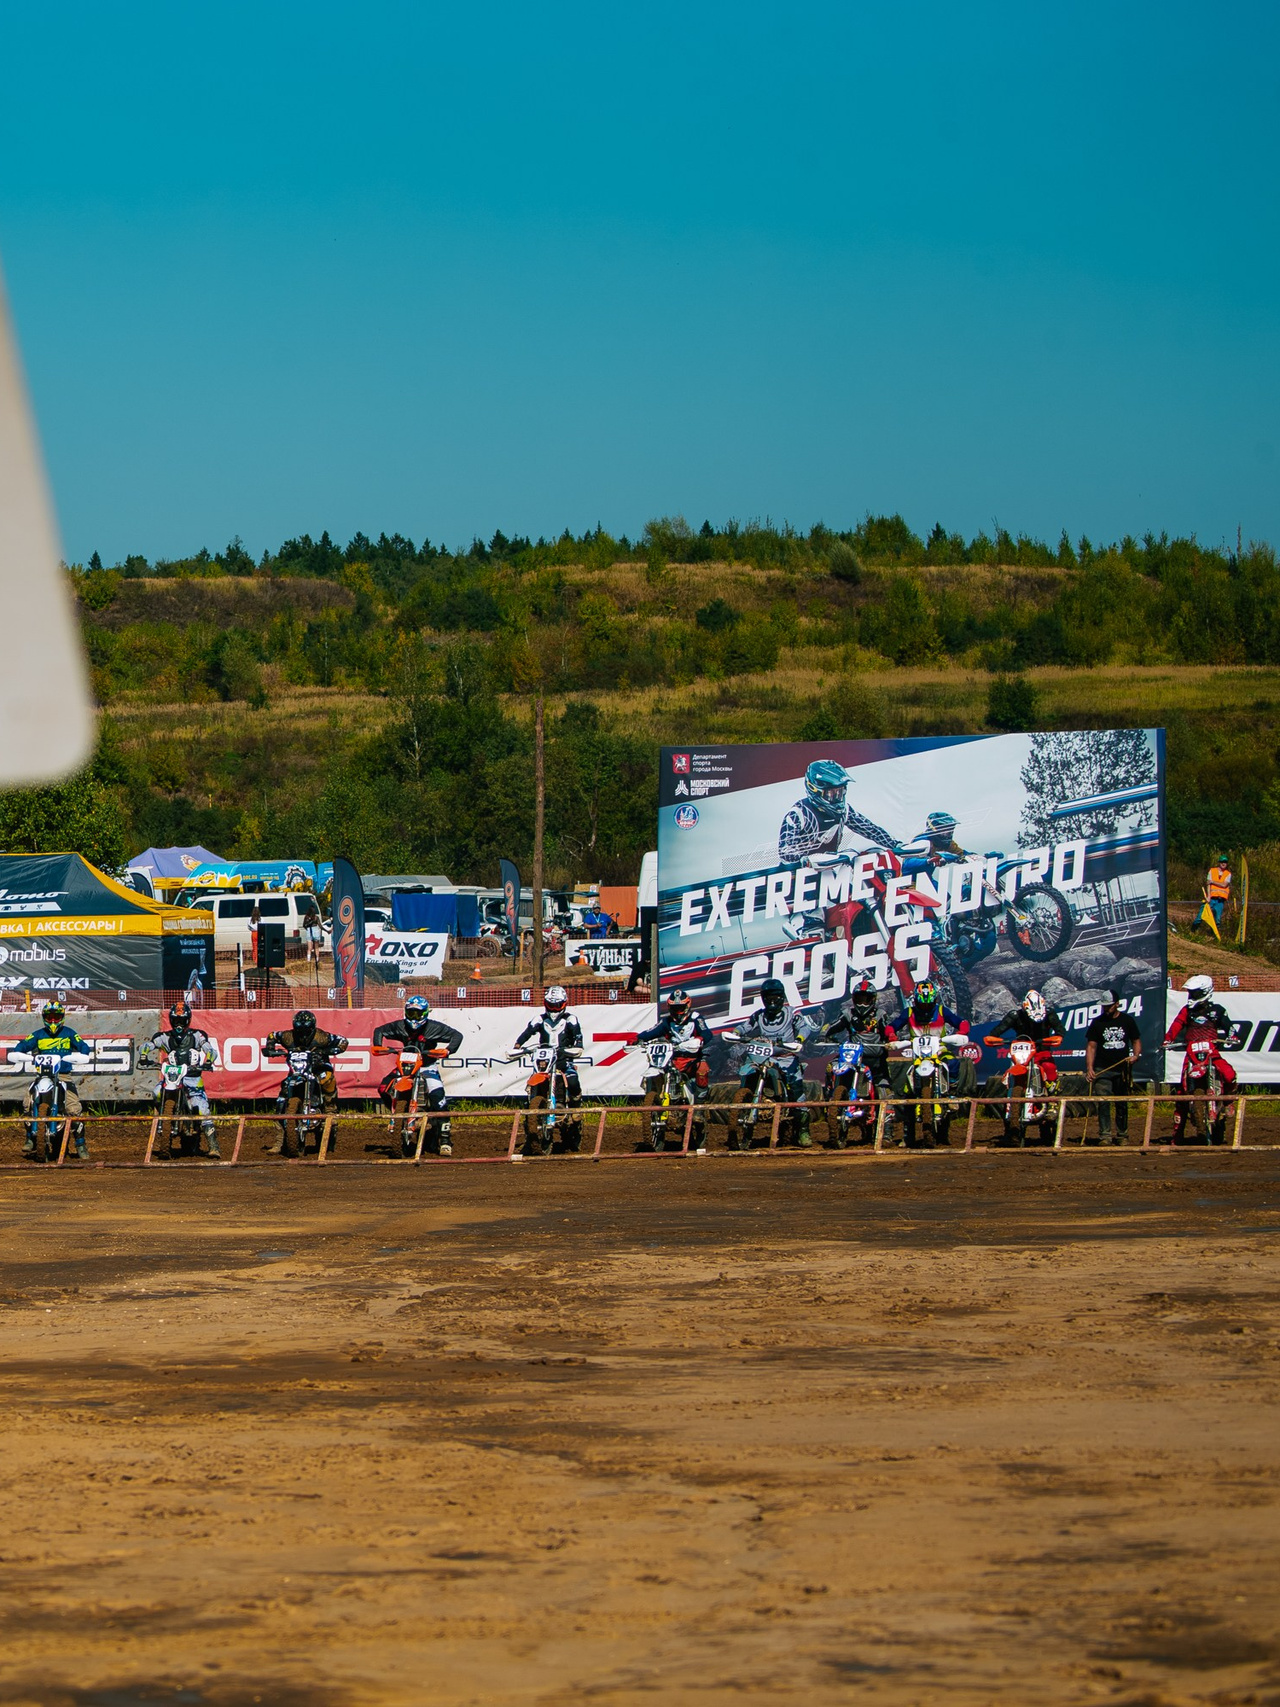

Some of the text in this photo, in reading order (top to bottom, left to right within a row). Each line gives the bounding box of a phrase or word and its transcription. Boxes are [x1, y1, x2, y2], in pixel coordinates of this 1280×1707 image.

[690, 778, 729, 788] МОСКОВСКИЙ
[690, 788, 709, 796] СПОРТ
[679, 839, 1086, 936] EXTREME ENDURO
[35, 919, 116, 932] АКСЕССУАРЫ
[10, 942, 66, 962] mobius
[728, 921, 933, 1019] CROSS
[59, 992, 66, 1001] 5
[119, 990, 126, 1000] 6
[185, 991, 191, 1001] 7
[248, 991, 255, 1001] 8
[329, 989, 336, 999] 9
[397, 989, 406, 998] 10
[458, 987, 466, 997] 11
[522, 990, 531, 1000] 12
[918, 1037, 931, 1047] 97
[593, 1033, 639, 1066] 7
[650, 1045, 667, 1055] 100
[748, 1045, 771, 1056] 858
[1012, 1045, 1030, 1053] 941
[538, 1051, 547, 1059] 9
[38, 1056, 53, 1066] 23
